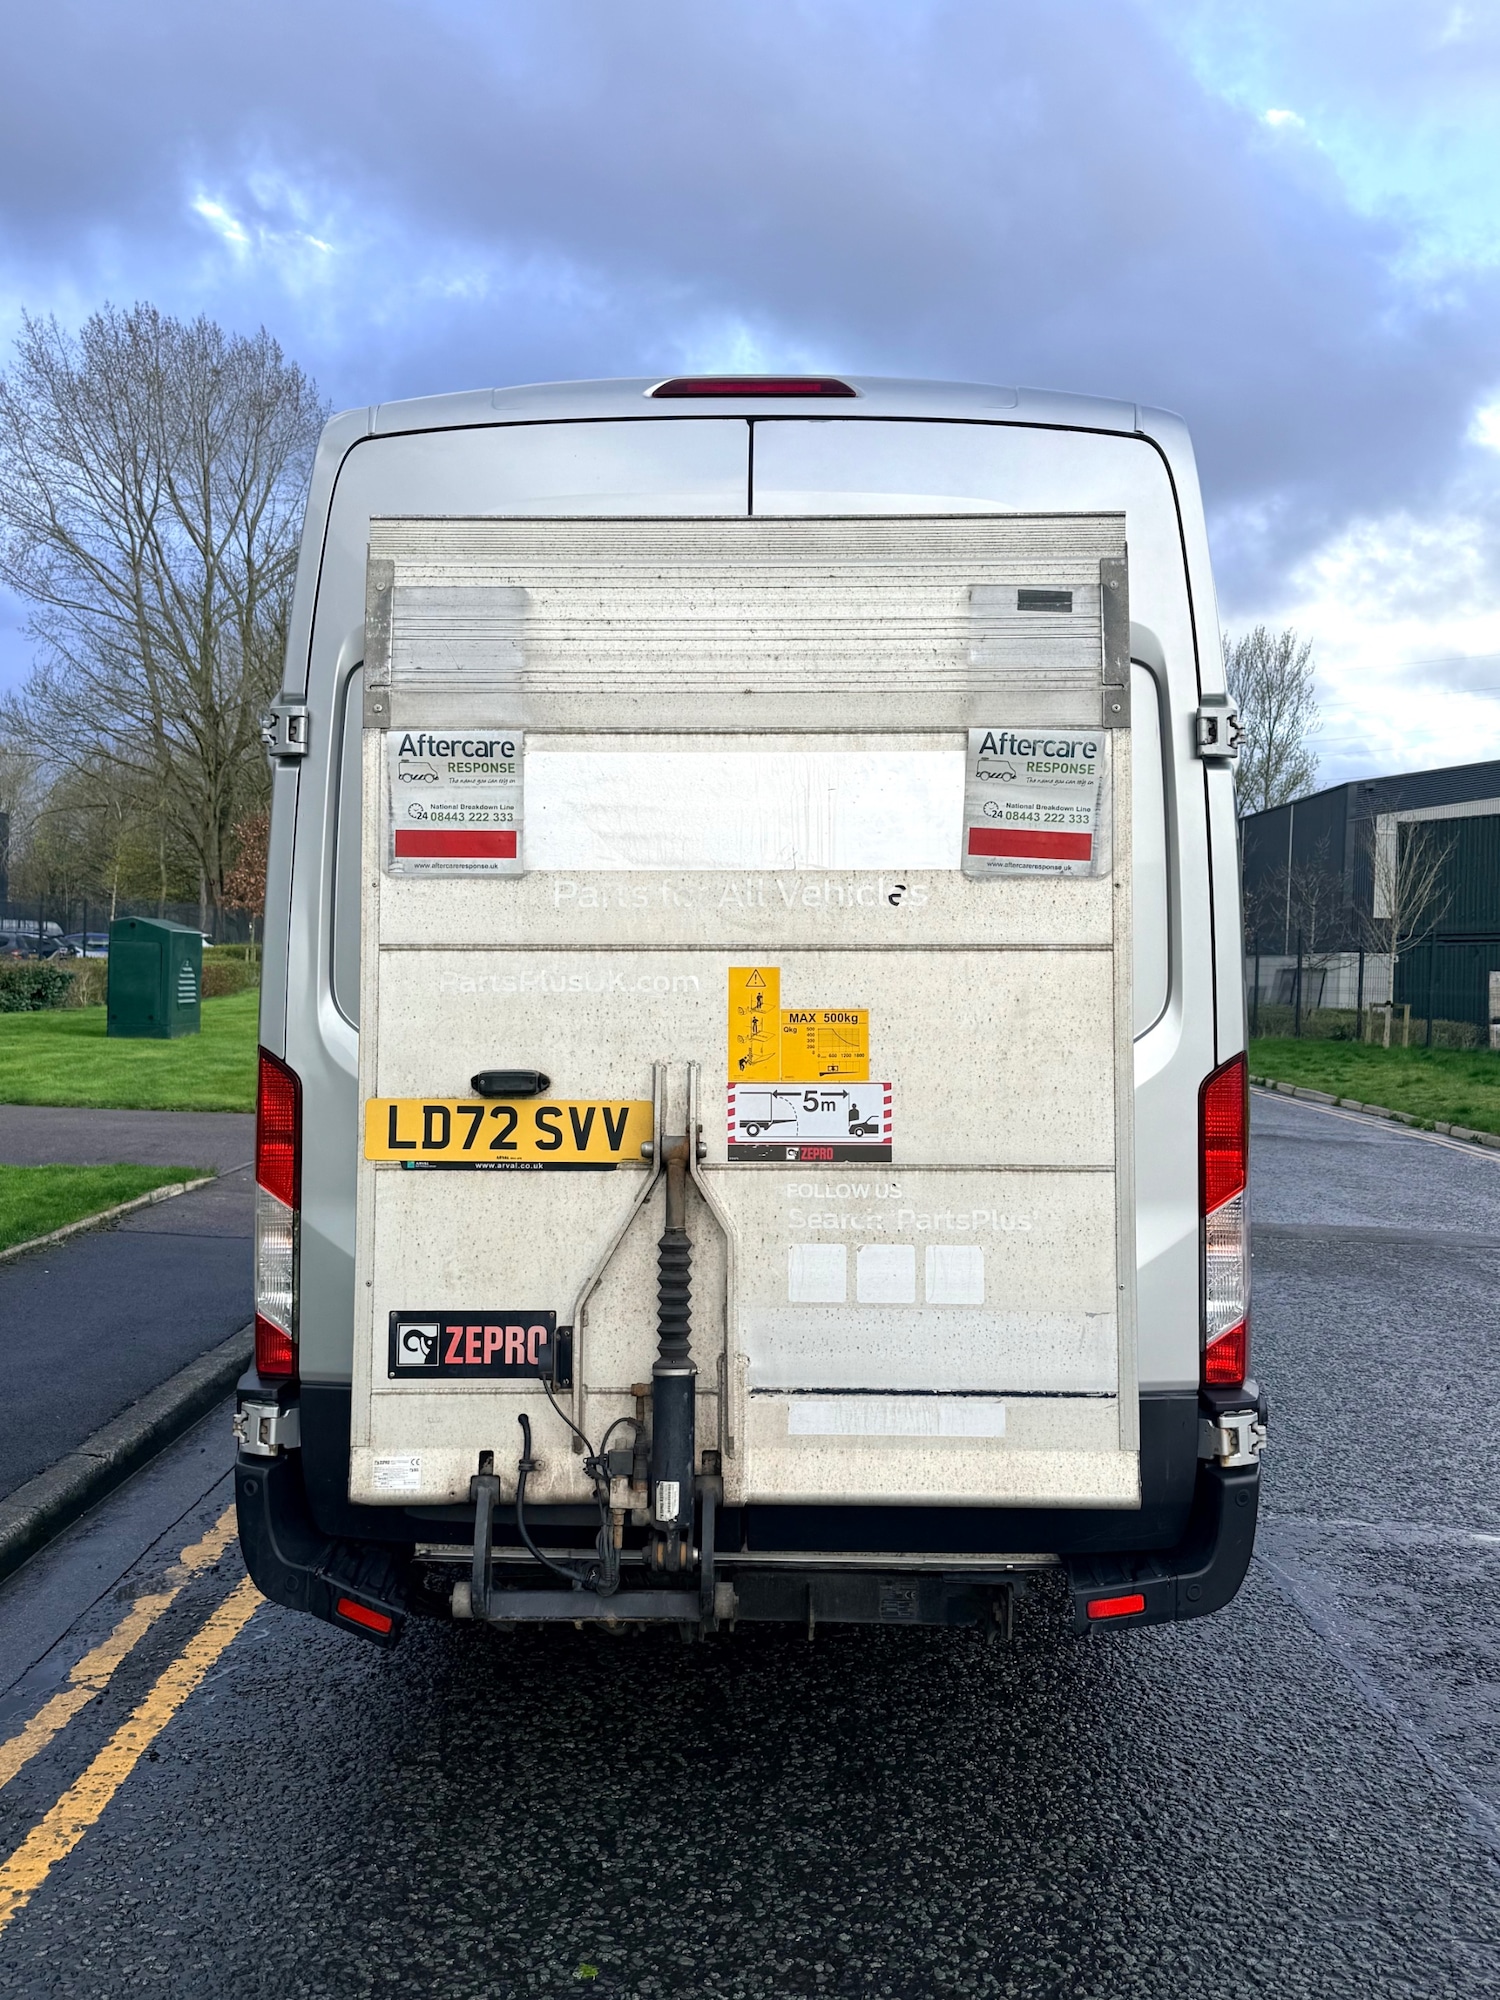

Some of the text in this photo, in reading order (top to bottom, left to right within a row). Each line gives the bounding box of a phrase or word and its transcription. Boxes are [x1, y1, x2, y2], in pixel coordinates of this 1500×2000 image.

[398, 733, 516, 758] Aftercare
[978, 731, 1098, 759] Aftercare
[447, 762, 516, 774] RESPONSE
[1026, 761, 1096, 775] RESPONSE
[416, 812, 514, 822] 24 08443 222 333
[991, 810, 1090, 824] 24 08443 222 333
[789, 1013, 858, 1024] MAX 500kg
[802, 1090, 836, 1113] 5m
[388, 1105, 629, 1151] LD72 SVV
[800, 1147, 834, 1160] ZEPRO
[786, 1183, 903, 1199] FOLLOW US
[444, 1325, 548, 1365] ZEPRO
